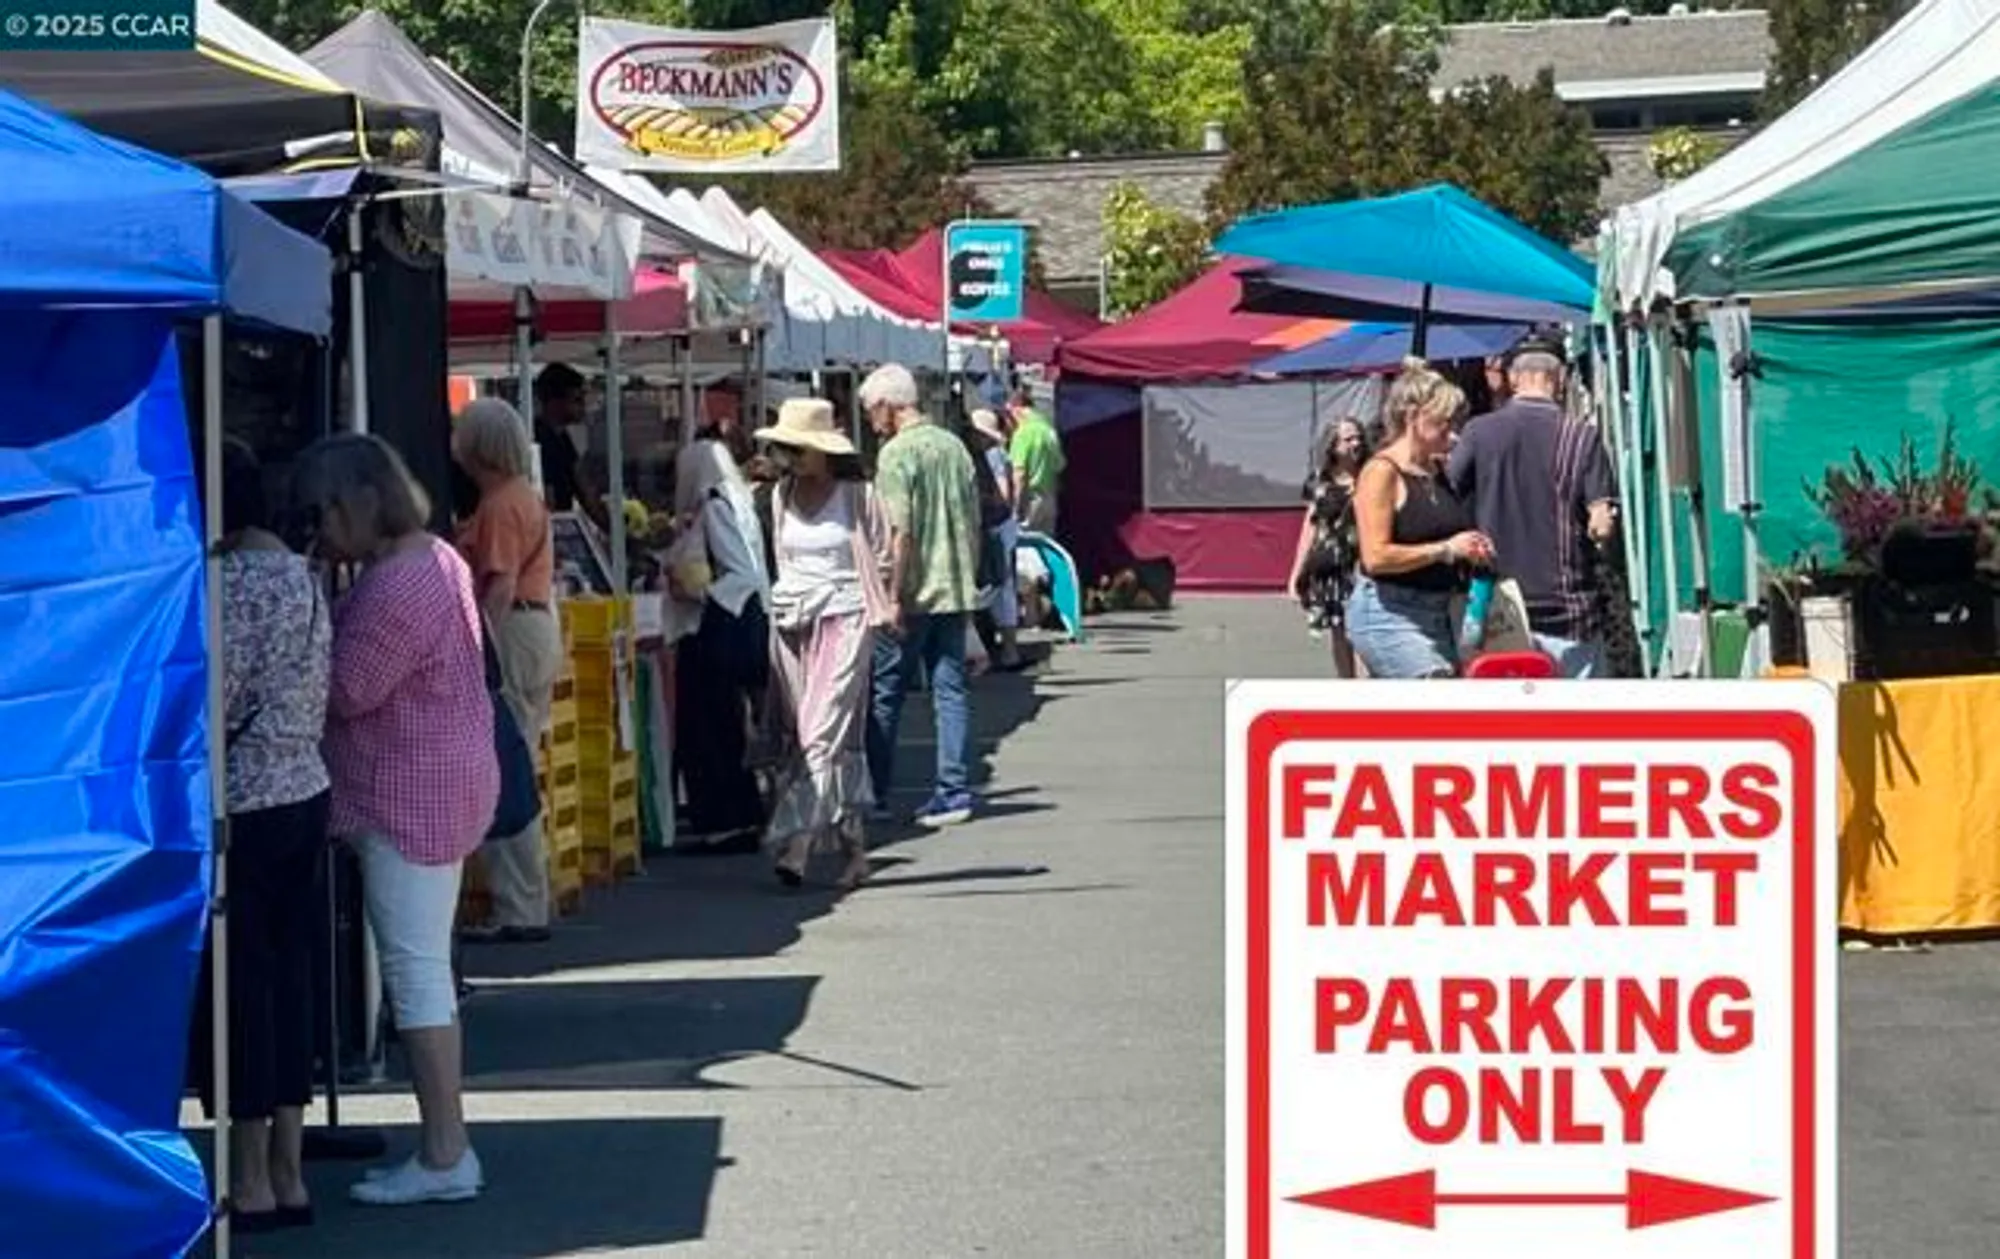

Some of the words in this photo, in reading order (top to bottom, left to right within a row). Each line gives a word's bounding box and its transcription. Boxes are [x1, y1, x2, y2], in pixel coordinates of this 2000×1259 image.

[618, 61, 793, 99] BECKMANN'S
[1283, 763, 1781, 839] FARMERS
[1307, 853, 1758, 926] MARKET
[1316, 976, 1753, 1054] PARKING
[1404, 1067, 1666, 1144] ONLY
